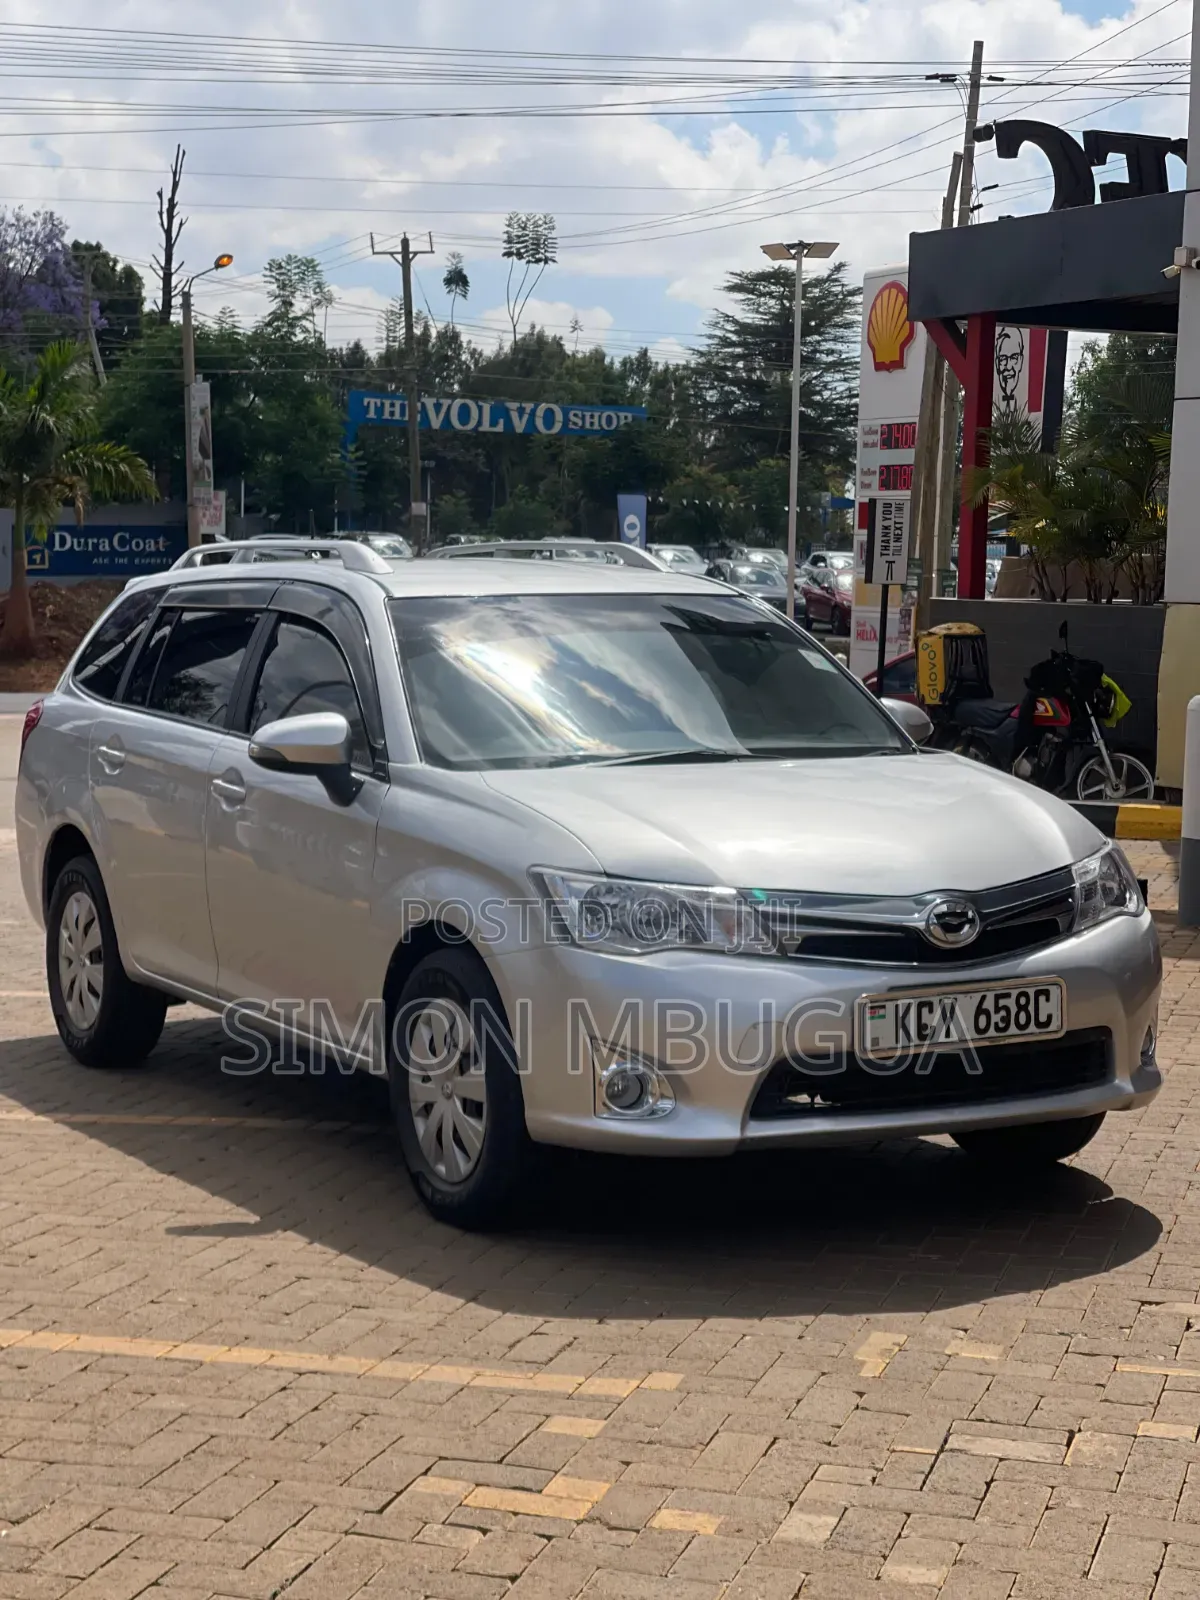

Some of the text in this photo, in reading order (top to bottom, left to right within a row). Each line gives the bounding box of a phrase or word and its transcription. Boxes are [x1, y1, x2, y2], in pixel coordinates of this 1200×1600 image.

[421, 397, 564, 435] VOLVO
[53, 531, 167, 552] DuraCoat
[880, 502, 892, 558] THANK YOU
[892, 501, 905, 557] TILL NEXT TIME
[114, 557, 129, 565] THE
[855, 627, 878, 642] HELIX
[927, 650, 939, 701] Glovo
[973, 988, 1053, 1036] 658C
